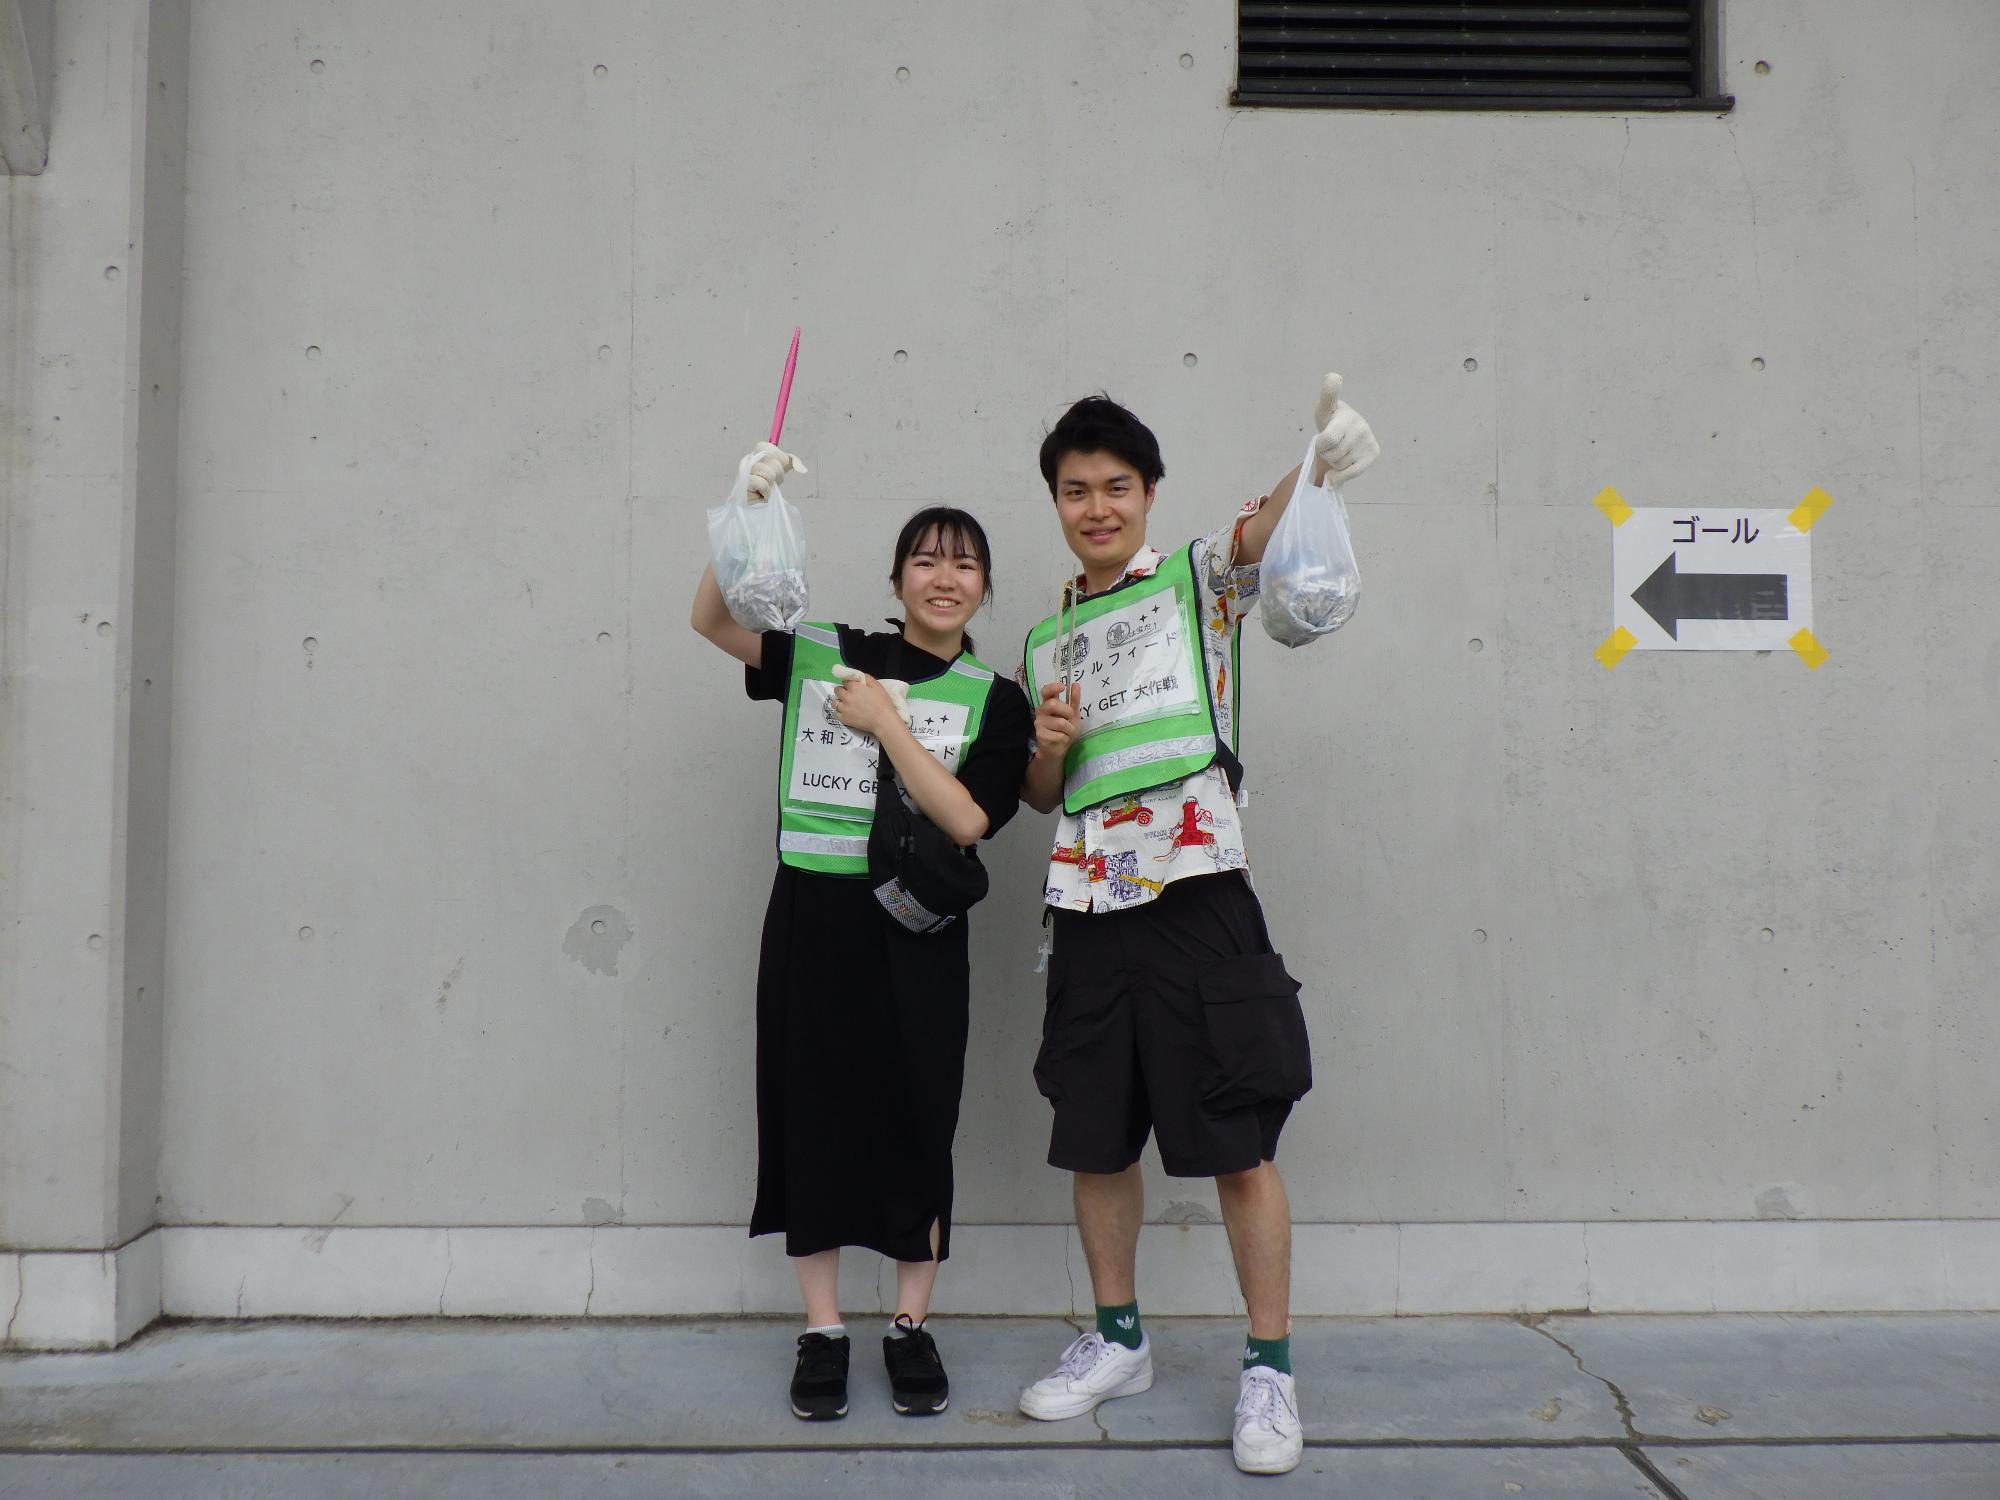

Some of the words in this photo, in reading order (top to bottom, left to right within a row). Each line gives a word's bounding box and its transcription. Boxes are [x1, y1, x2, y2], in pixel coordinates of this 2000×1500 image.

[1672, 515, 1760, 544] ゴール
[1098, 690, 1128, 711] GET
[1134, 674, 1179, 700] 大作戦
[802, 772, 852, 791] LUCKY
[858, 779, 879, 795] GE
